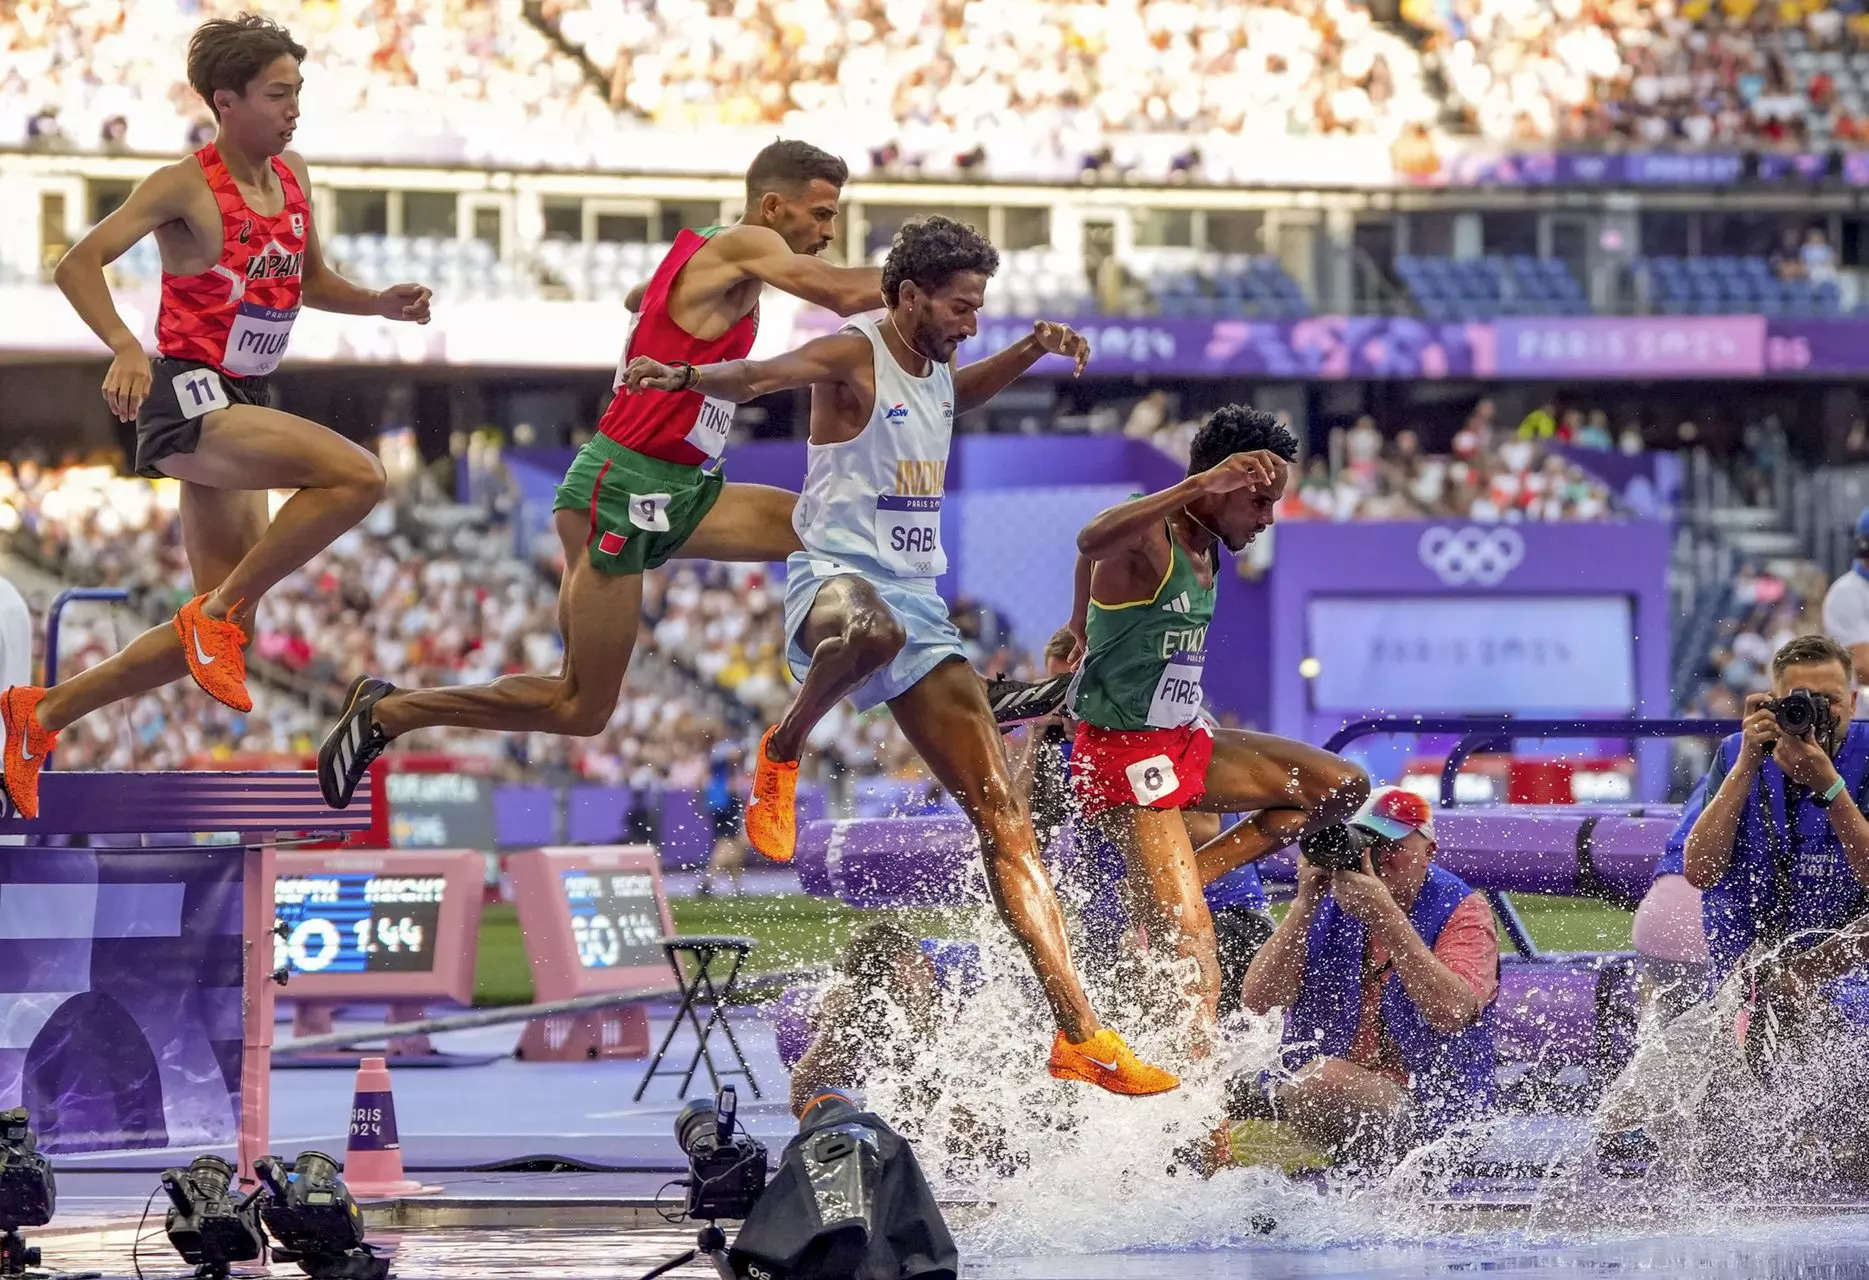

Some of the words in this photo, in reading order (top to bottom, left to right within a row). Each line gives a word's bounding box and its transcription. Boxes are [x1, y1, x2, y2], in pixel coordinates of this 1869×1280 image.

[185, 377, 216, 406] 11
[640, 500, 656, 522] 9
[906, 500, 929, 508] PARIS
[1161, 677, 1201, 705] FIRE
[1144, 766, 1164, 791] 8
